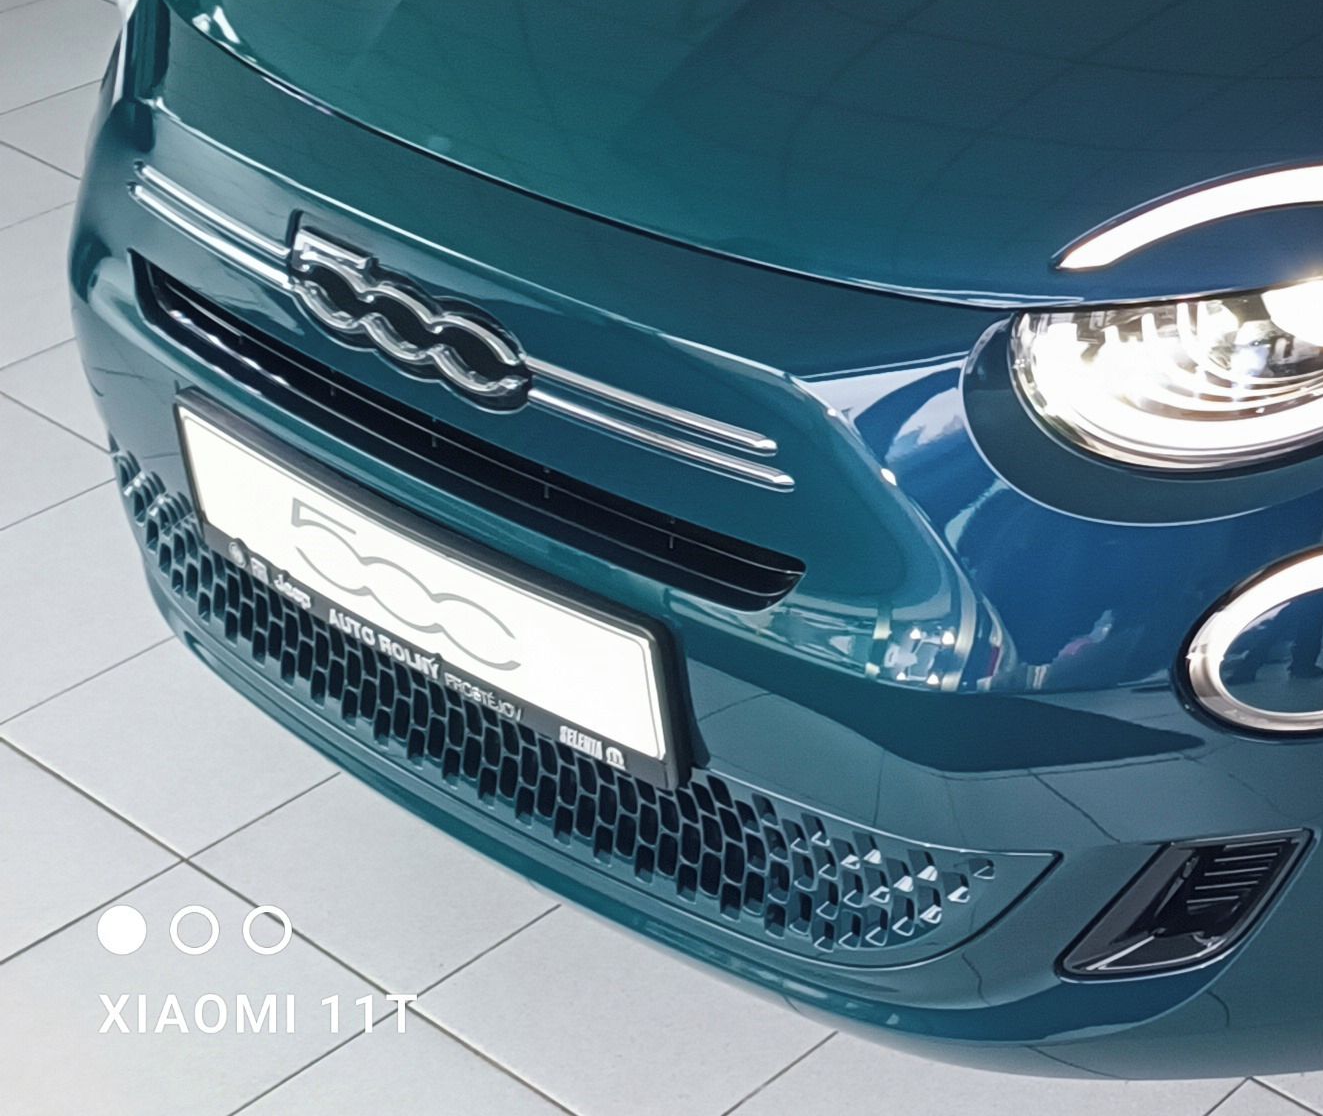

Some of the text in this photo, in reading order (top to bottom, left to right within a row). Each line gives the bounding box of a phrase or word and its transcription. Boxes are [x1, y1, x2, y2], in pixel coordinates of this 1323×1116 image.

[292, 226, 528, 399] 500
[290, 497, 521, 672] 500
[328, 608, 376, 646] AUTO
[378, 635, 441, 680] ROLNÝ
